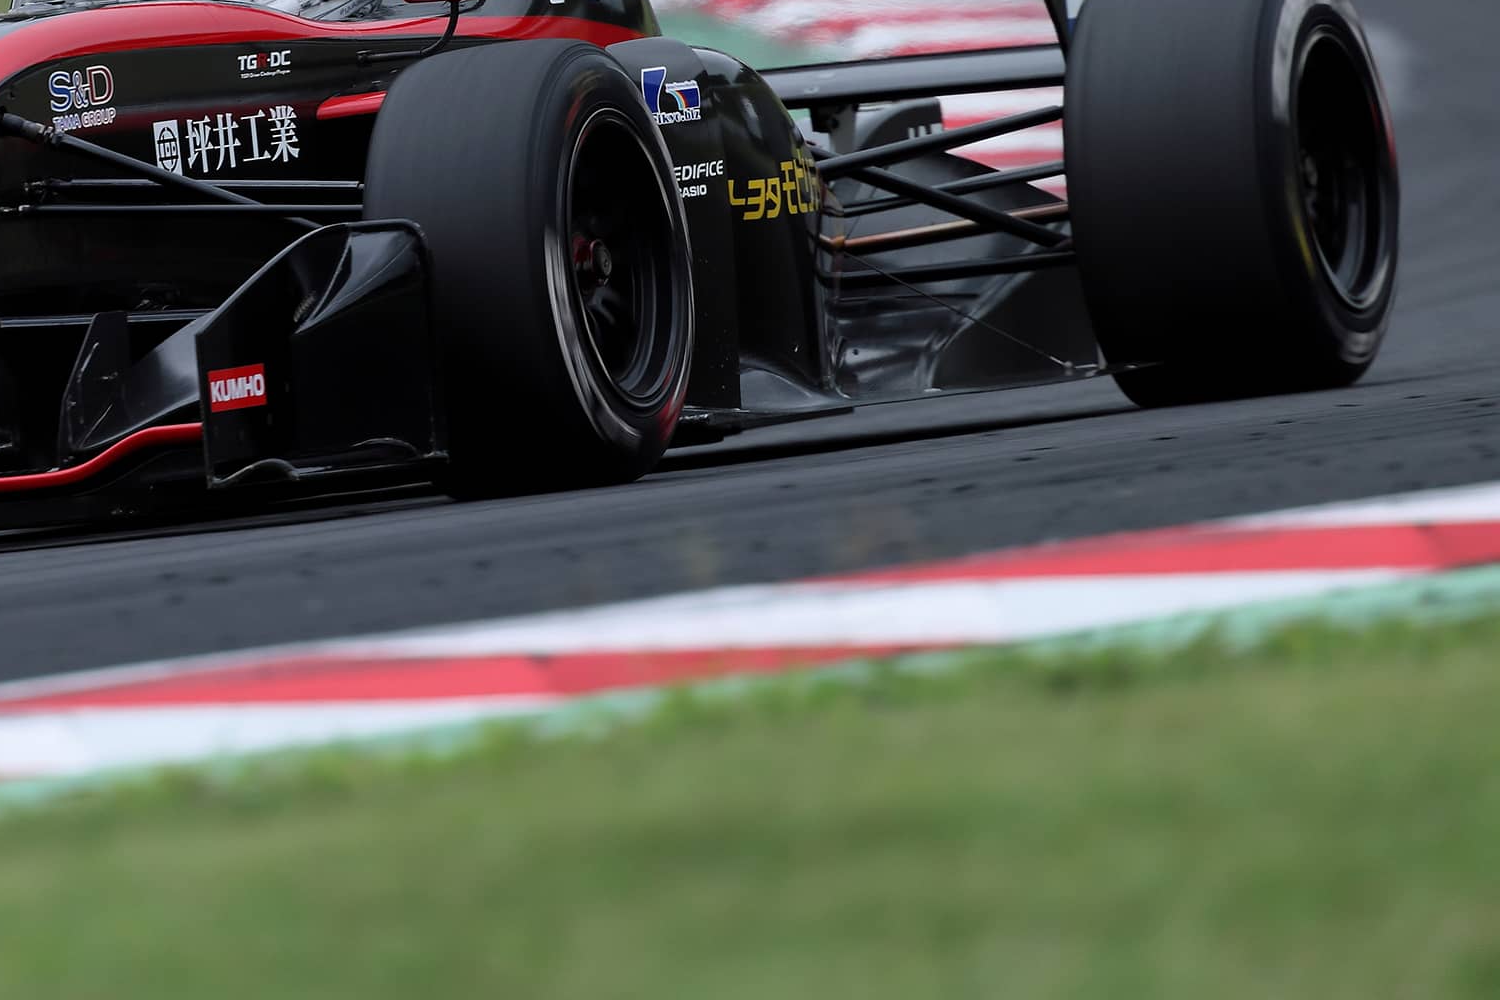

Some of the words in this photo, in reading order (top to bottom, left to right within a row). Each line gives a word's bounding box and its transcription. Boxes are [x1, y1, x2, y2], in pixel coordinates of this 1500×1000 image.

[49, 65, 114, 112] S&D
[81, 107, 116, 127] GROUP
[186, 105, 300, 173] 坪井工業
[673, 160, 723, 181] EDIFICE
[210, 374, 265, 402] KUMHO
